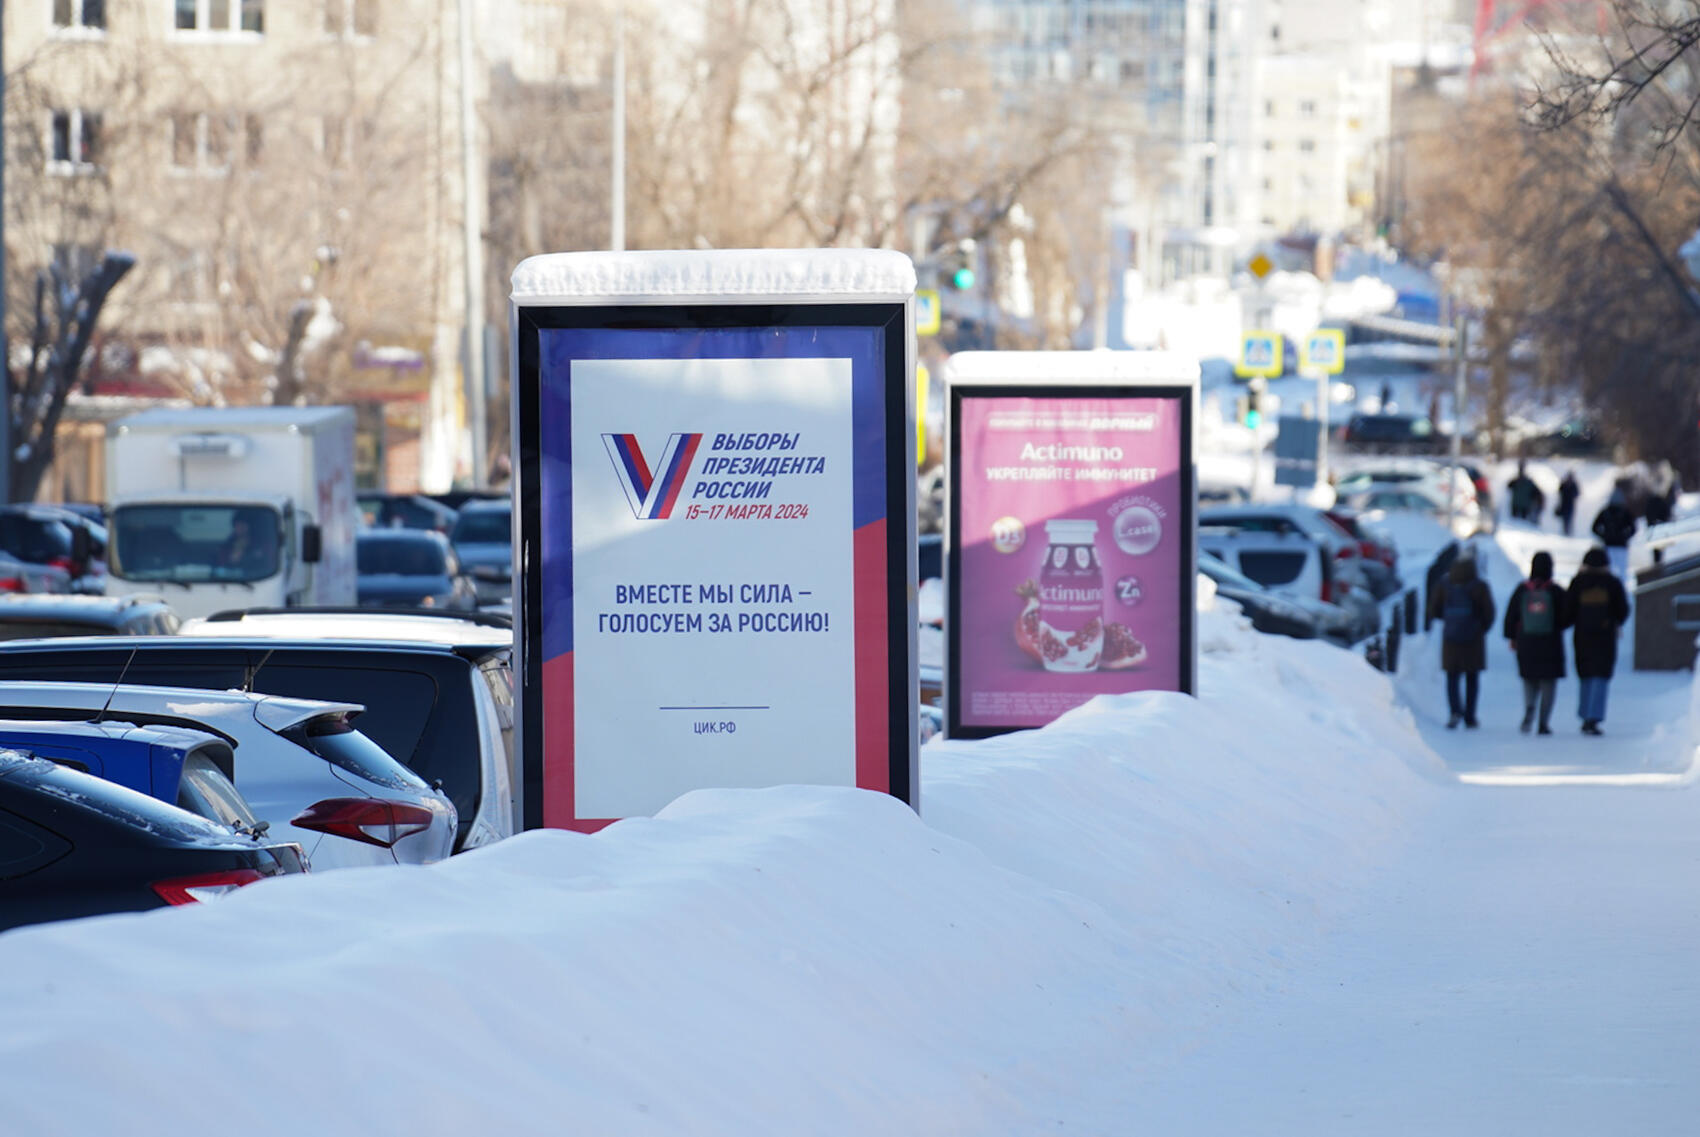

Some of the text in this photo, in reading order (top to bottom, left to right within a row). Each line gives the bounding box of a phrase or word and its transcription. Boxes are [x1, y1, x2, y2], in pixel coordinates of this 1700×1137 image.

[711, 433, 800, 451] ВЫБОРЫ
[1020, 442, 1124, 461] Actimuno
[701, 457, 826, 477] ПРЕЗИДЕНТА
[986, 466, 1157, 481] УКРЕПЛЯЙТЕ ИММУНИТЕТ
[692, 481, 772, 499] РОССИИ
[725, 504, 772, 520] МАРТА
[774, 504, 809, 520] 2024
[616, 585, 693, 604] ВМЕСТЕ
[699, 584, 733, 604] МЫ
[740, 584, 793, 604] СИЛА
[599, 612, 829, 633] ГОЛОСУЕМ ЗА РОССИЮ!
[693, 722, 737, 735] ЦИК.РФ
